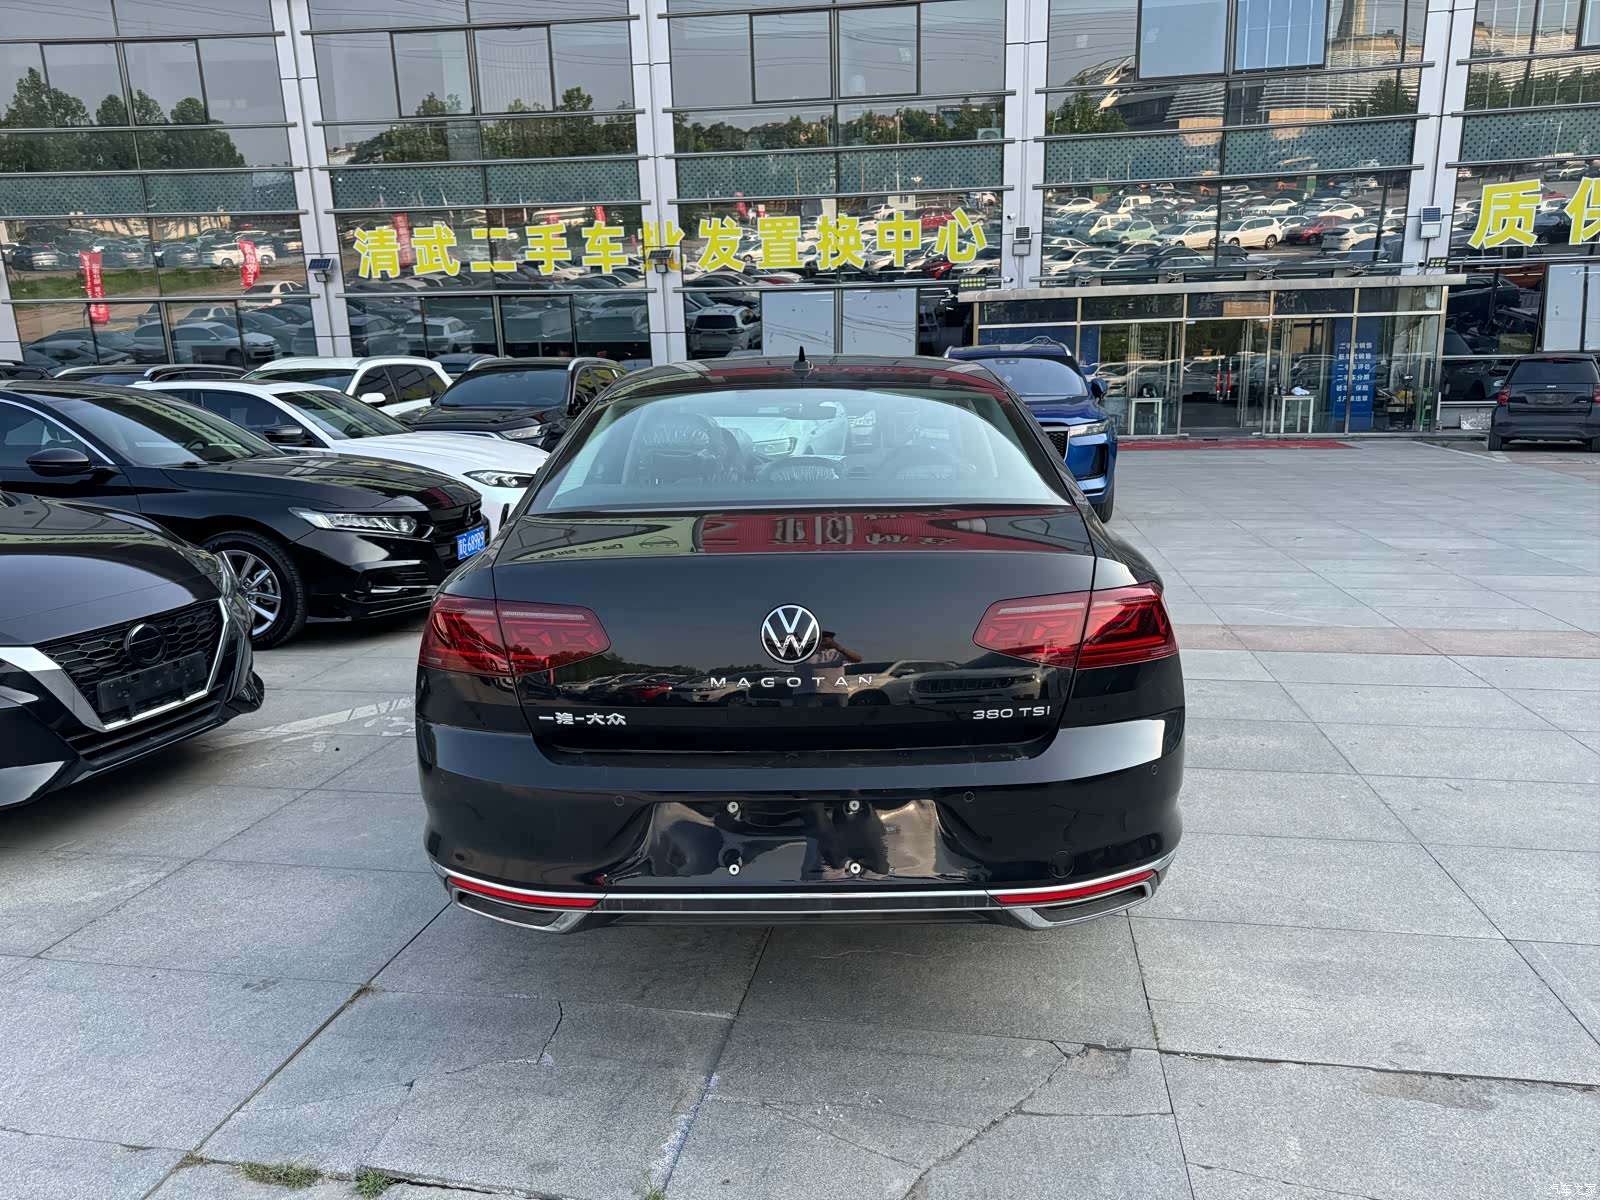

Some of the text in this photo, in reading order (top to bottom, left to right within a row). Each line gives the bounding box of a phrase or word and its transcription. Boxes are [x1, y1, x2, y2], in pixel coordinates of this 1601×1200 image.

[353, 206, 988, 279] 清武二手车批发置换中心
[710, 675, 872, 688] MAGOTAN
[972, 705, 1051, 720] 380 TSI
